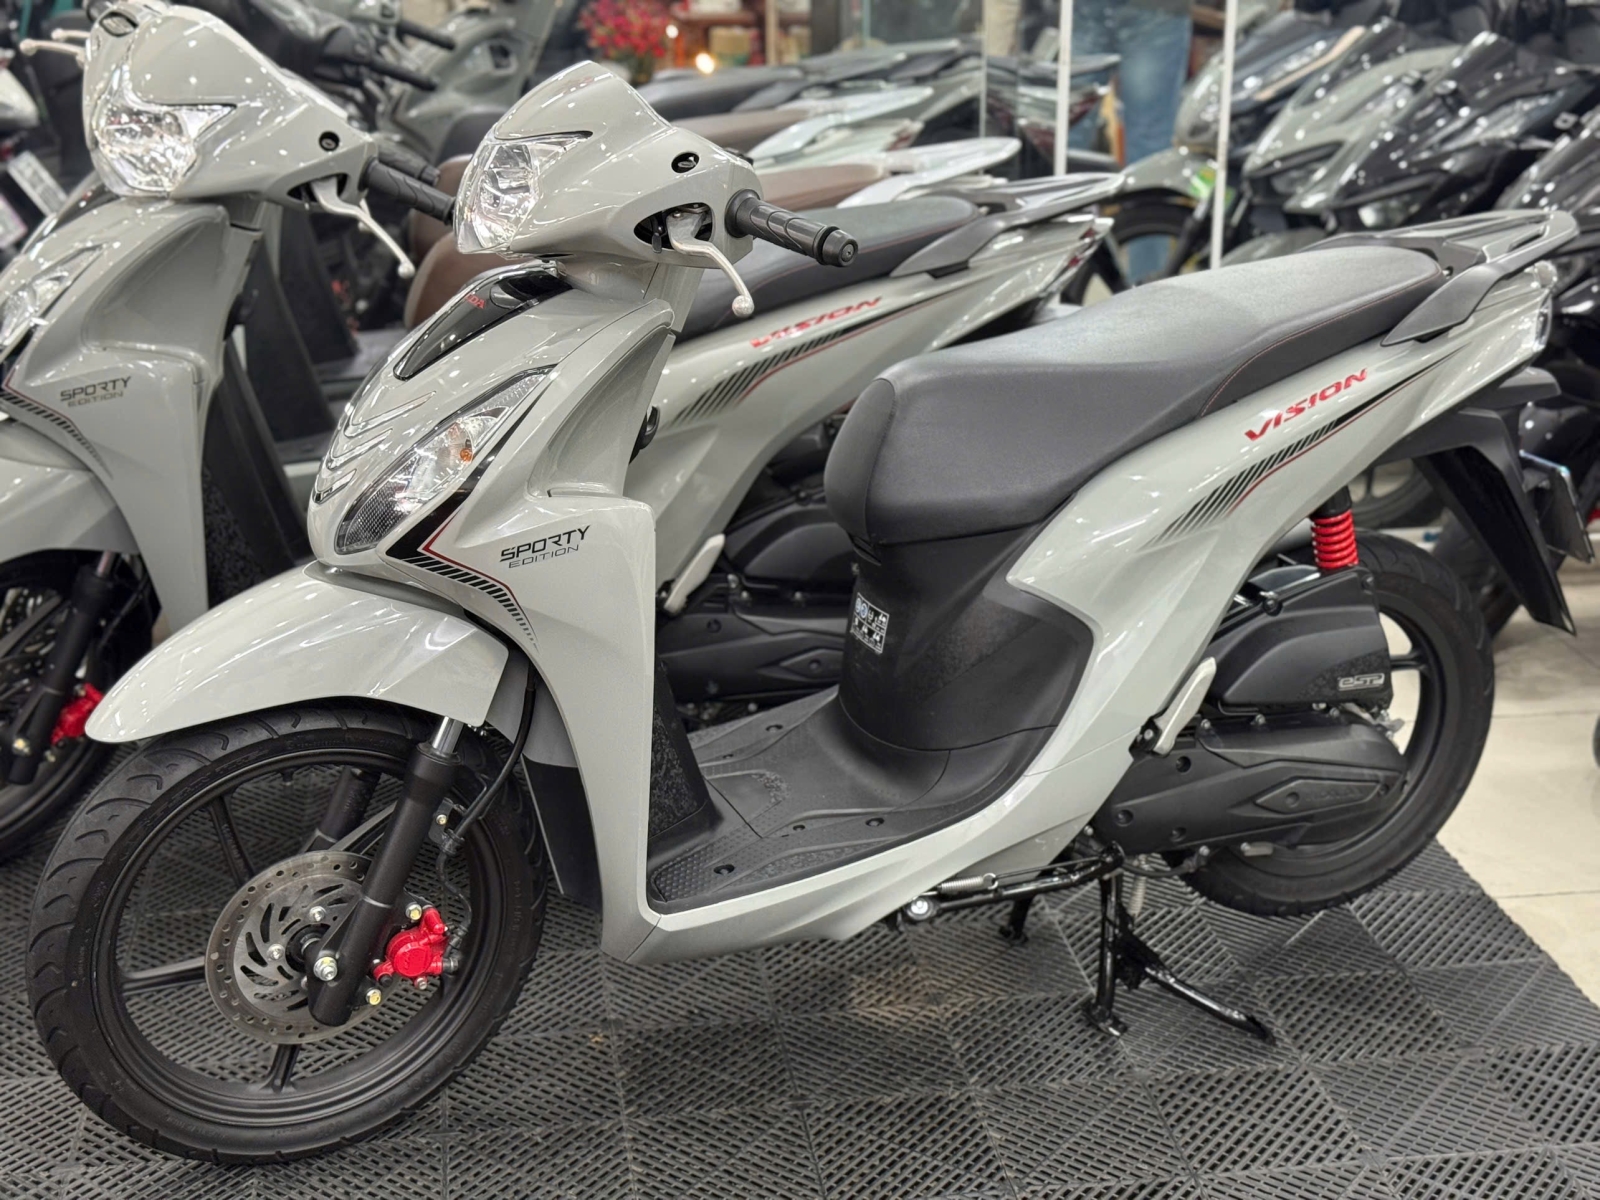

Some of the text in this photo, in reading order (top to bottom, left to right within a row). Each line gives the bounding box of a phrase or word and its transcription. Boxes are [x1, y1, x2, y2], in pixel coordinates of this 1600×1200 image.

[60, 376, 131, 402] SPORTY
[67, 391, 123, 407] EDITION
[1244, 367, 1367, 441] VISION
[500, 525, 590, 562] SPORTY
[508, 544, 579, 568] EDITION
